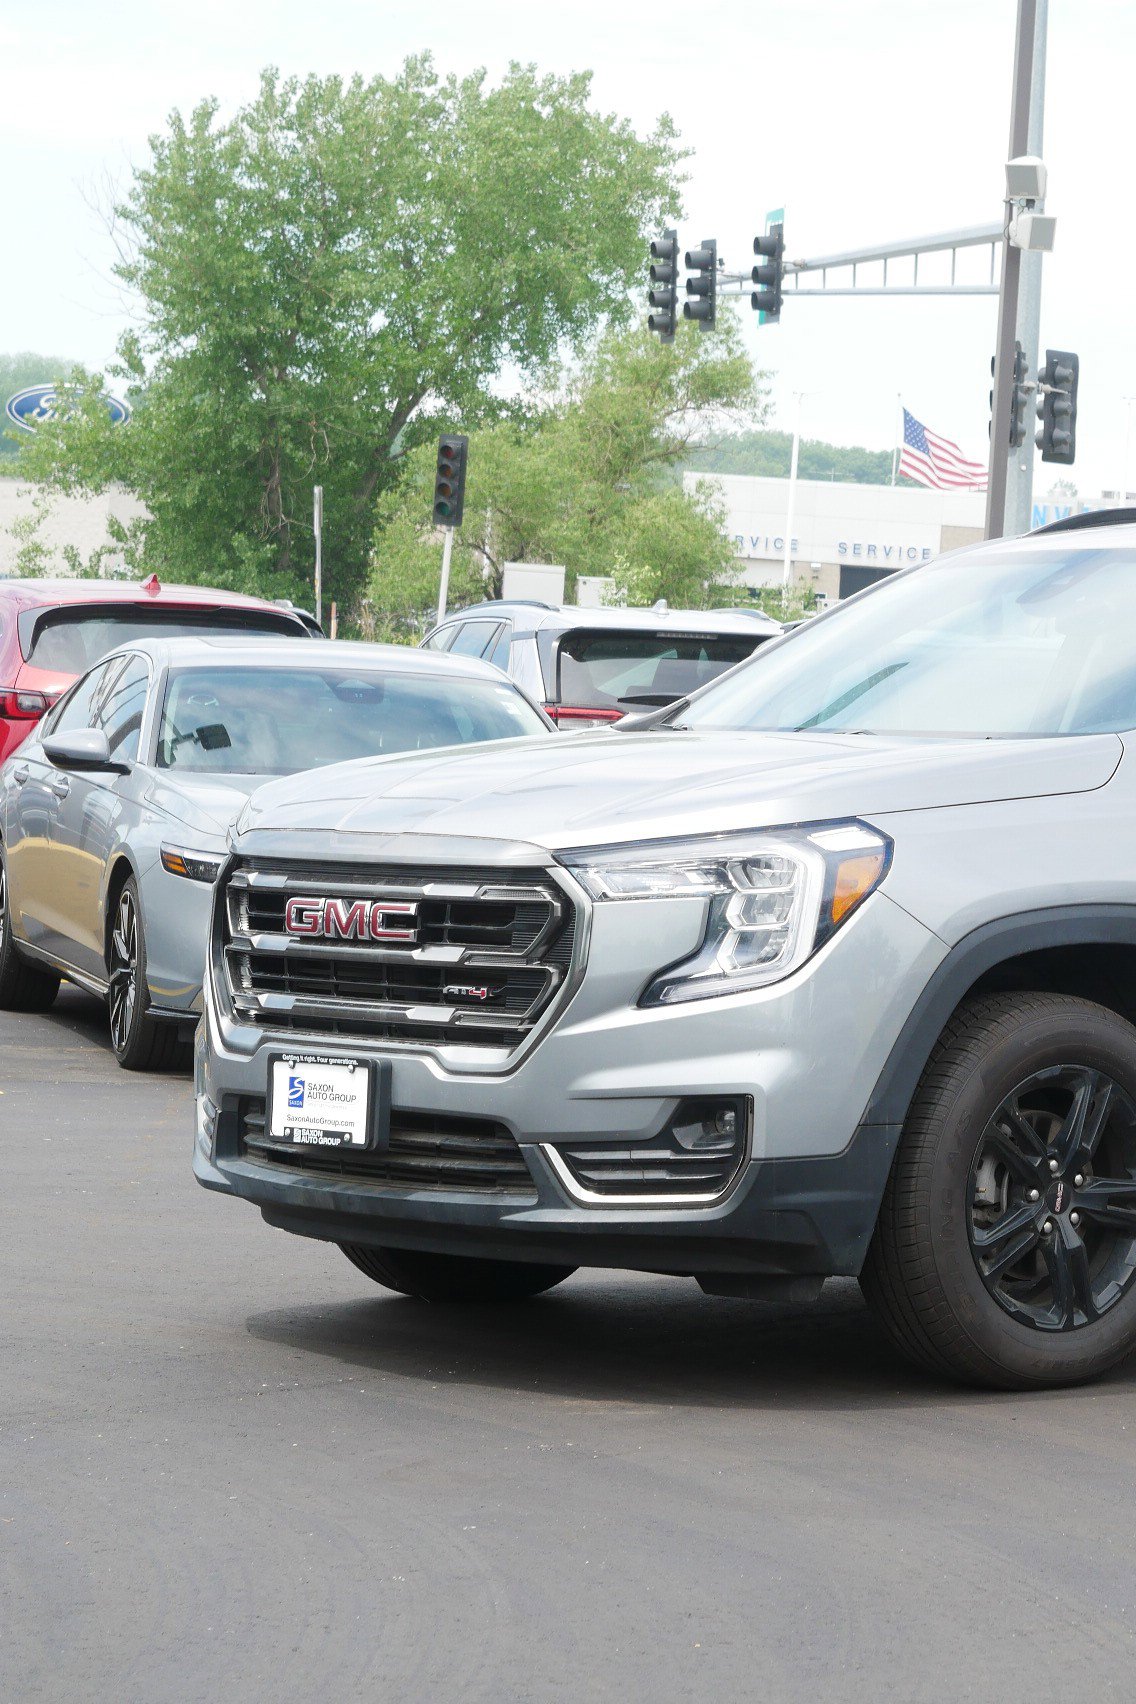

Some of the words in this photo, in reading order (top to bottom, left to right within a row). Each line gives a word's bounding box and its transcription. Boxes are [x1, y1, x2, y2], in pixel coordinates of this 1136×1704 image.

[838, 542, 931, 560] SERVICE
[285, 897, 417, 942] GMC
[282, 1053, 299, 1062] Getting
[307, 1083, 334, 1092] SAXON
[307, 1092, 327, 1101] AUTO
[329, 1093, 357, 1103] GROUP
[286, 1114, 355, 1127] SaxonAutoGroup.com
[301, 1129, 323, 1137] SAXON
[301, 1136, 318, 1144] AUTO
